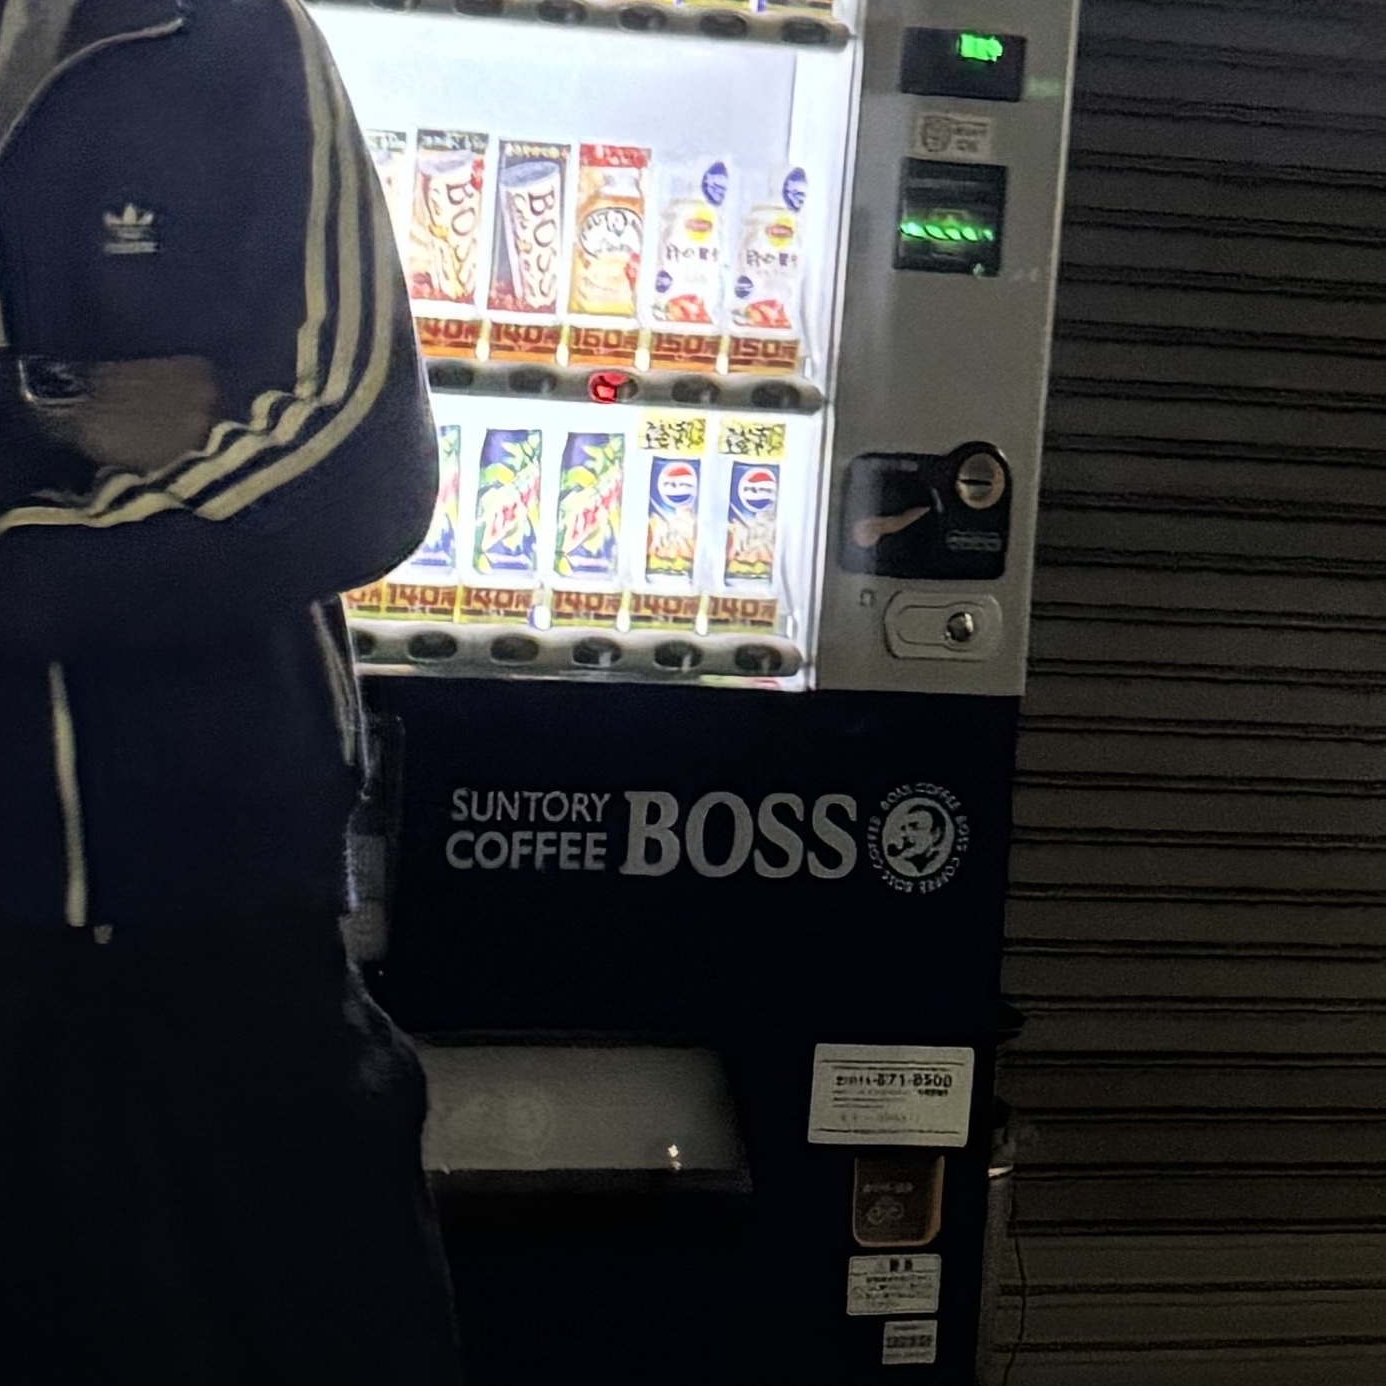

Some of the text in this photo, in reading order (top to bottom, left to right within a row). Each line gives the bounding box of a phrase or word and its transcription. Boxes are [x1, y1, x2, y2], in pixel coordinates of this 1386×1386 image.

[451, 787, 611, 823] SUNTORY
[445, 829, 608, 871] COFFEE
[618, 790, 858, 880] BOSS
